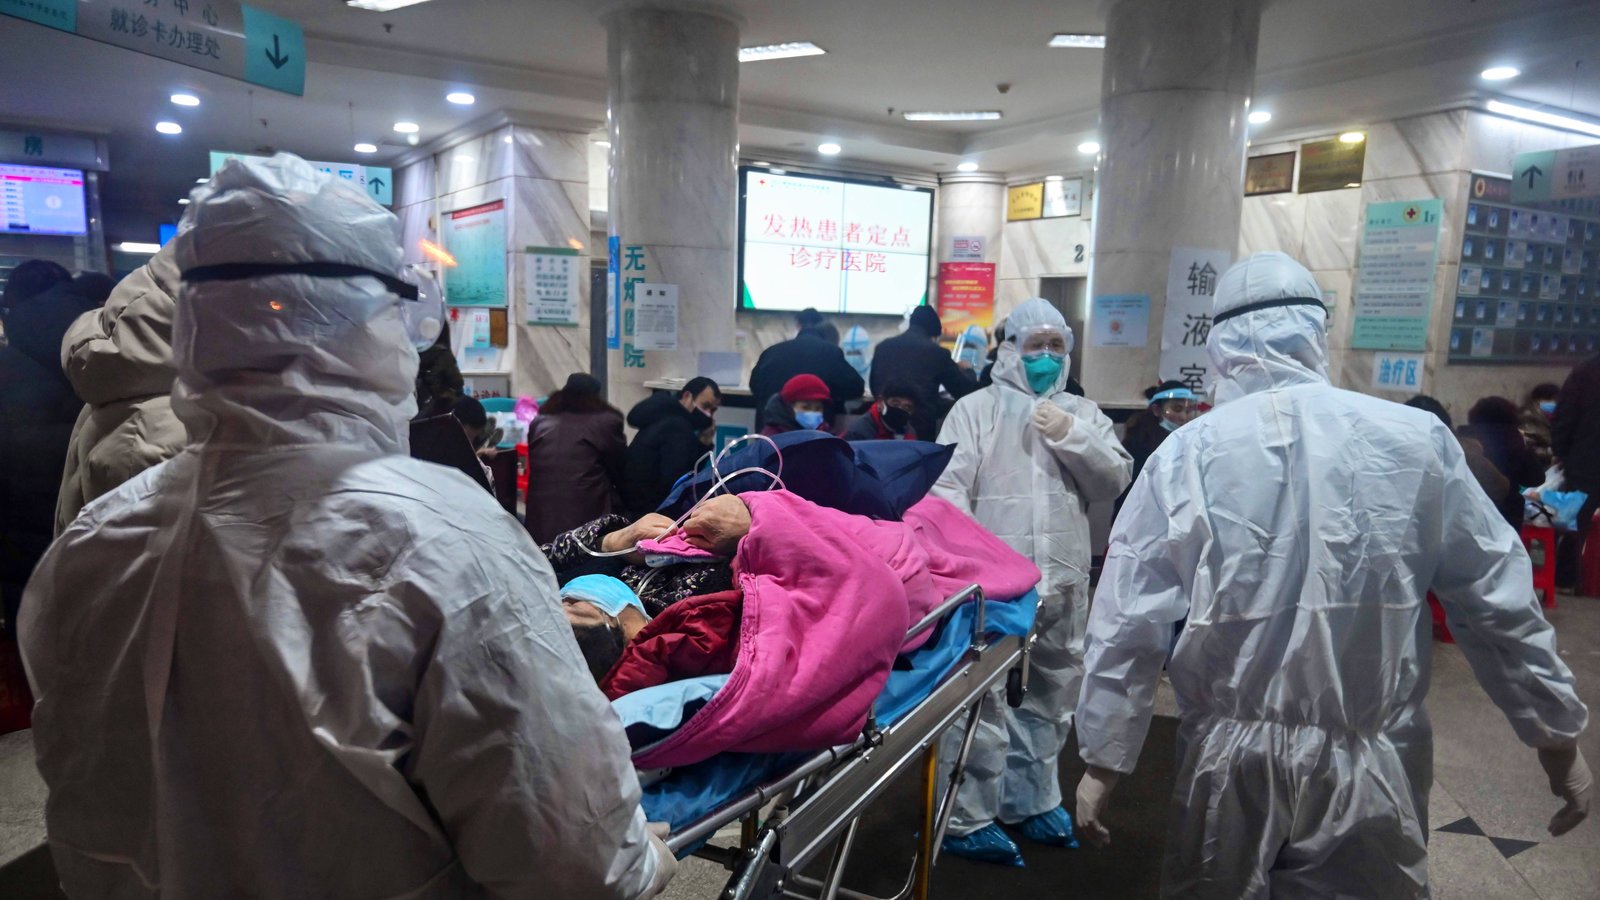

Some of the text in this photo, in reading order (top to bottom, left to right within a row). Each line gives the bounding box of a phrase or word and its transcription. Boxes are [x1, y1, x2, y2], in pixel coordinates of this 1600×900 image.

[110, 6, 221, 60] 就诊卡办理处
[762, 213, 911, 248] 发热患者定点
[789, 245, 887, 273] 诊疗医院
[1074, 243, 1084, 263] 2
[1180, 260, 1217, 397] 输液室
[1378, 357, 1418, 386] 治疗区
